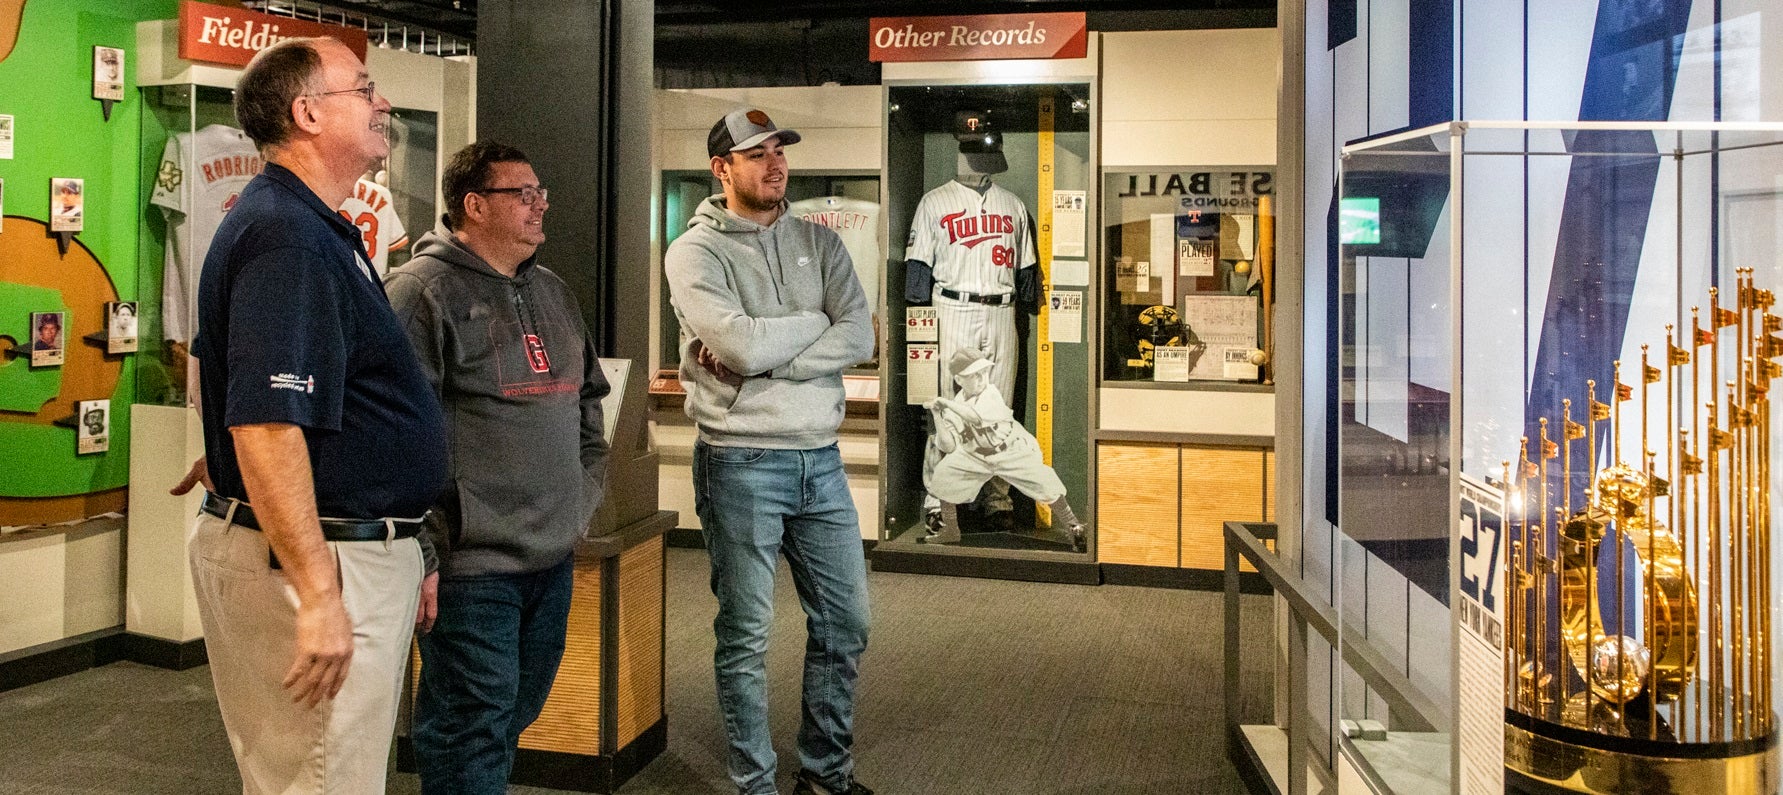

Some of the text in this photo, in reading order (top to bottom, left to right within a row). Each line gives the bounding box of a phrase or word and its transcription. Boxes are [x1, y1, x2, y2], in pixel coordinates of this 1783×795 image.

[198, 17, 291, 51] Fieldi
[875, 21, 1047, 48] Other Records
[353, 182, 388, 212] RAY
[940, 208, 1014, 245] Twins
[1188, 210, 1202, 223] T
[340, 210, 379, 260] 3
[992, 244, 1015, 269] 60
[1181, 245, 1212, 258] PLAYED
[908, 318, 934, 327] 6 11
[909, 350, 934, 359] 3 7
[1460, 497, 1502, 614] 27
